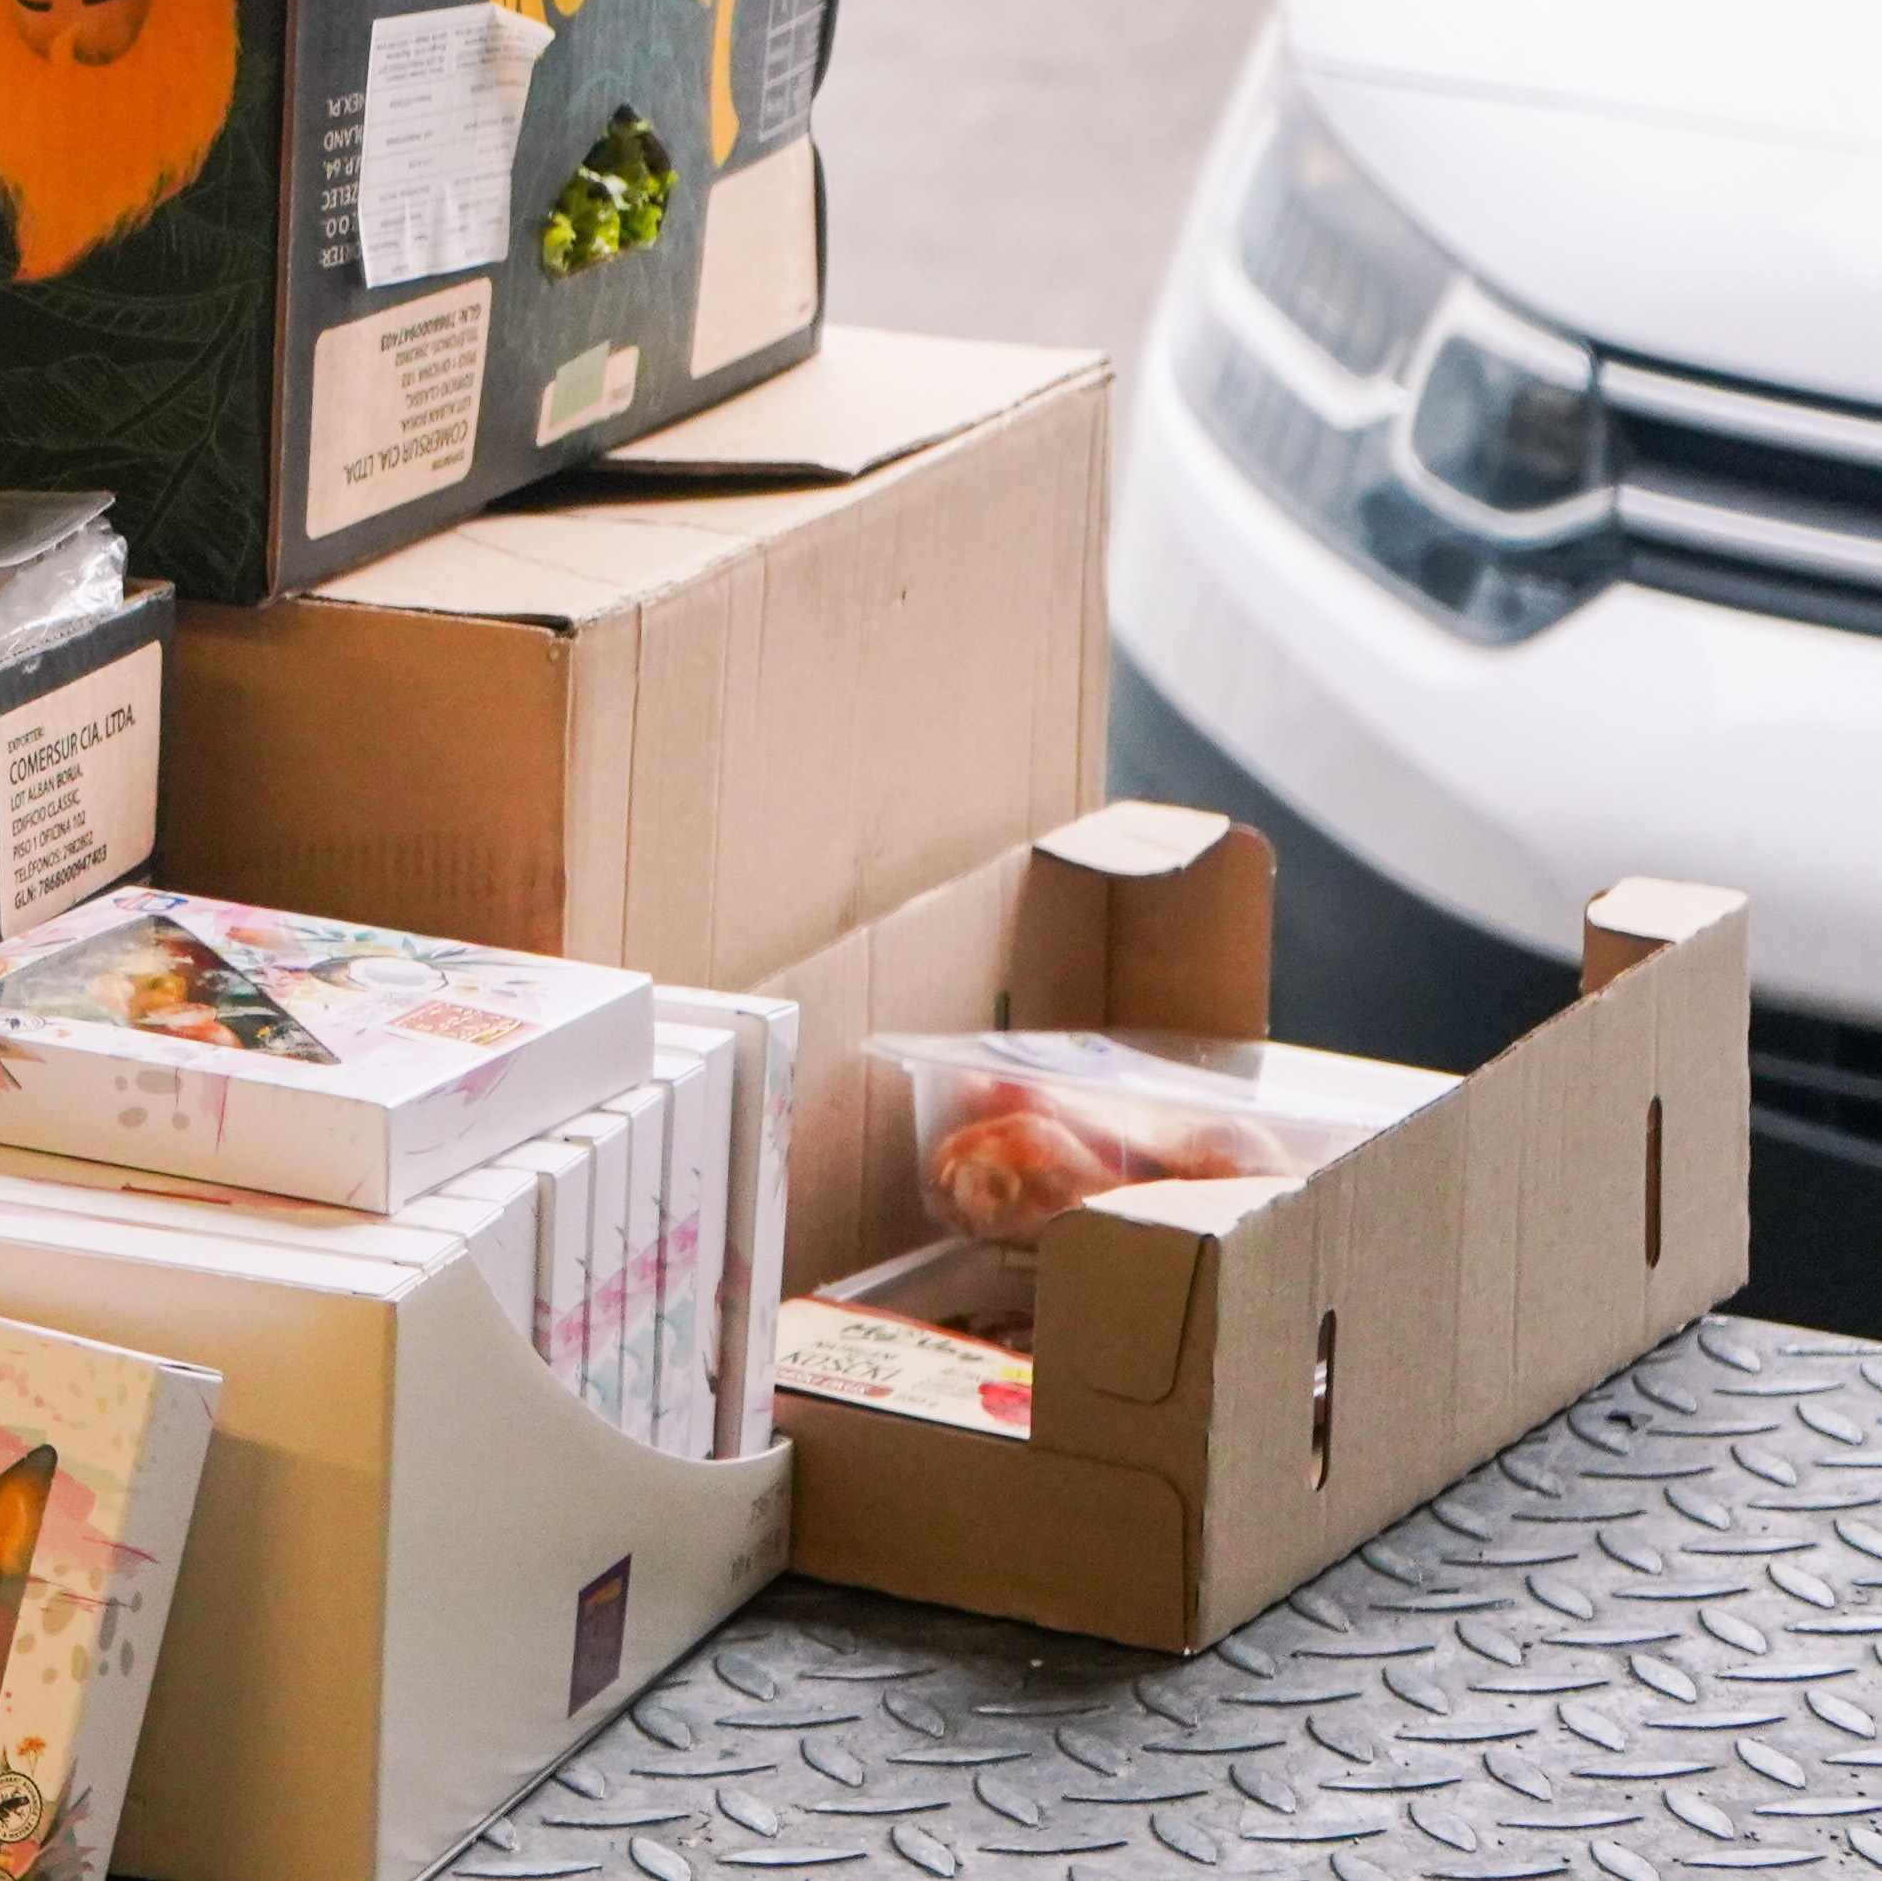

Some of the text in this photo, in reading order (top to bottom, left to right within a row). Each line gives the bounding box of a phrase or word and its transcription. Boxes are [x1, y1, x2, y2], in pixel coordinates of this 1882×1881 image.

[402, 420, 469, 464] COMERSUR
[9, 703, 136, 785] COMERSUR CIA. LTDA.
[11, 804, 47, 837] EDIFICIO
[12, 840, 33, 863] PISO
[40, 822, 72, 852] OFICINA
[13, 884, 38, 910] GLN:
